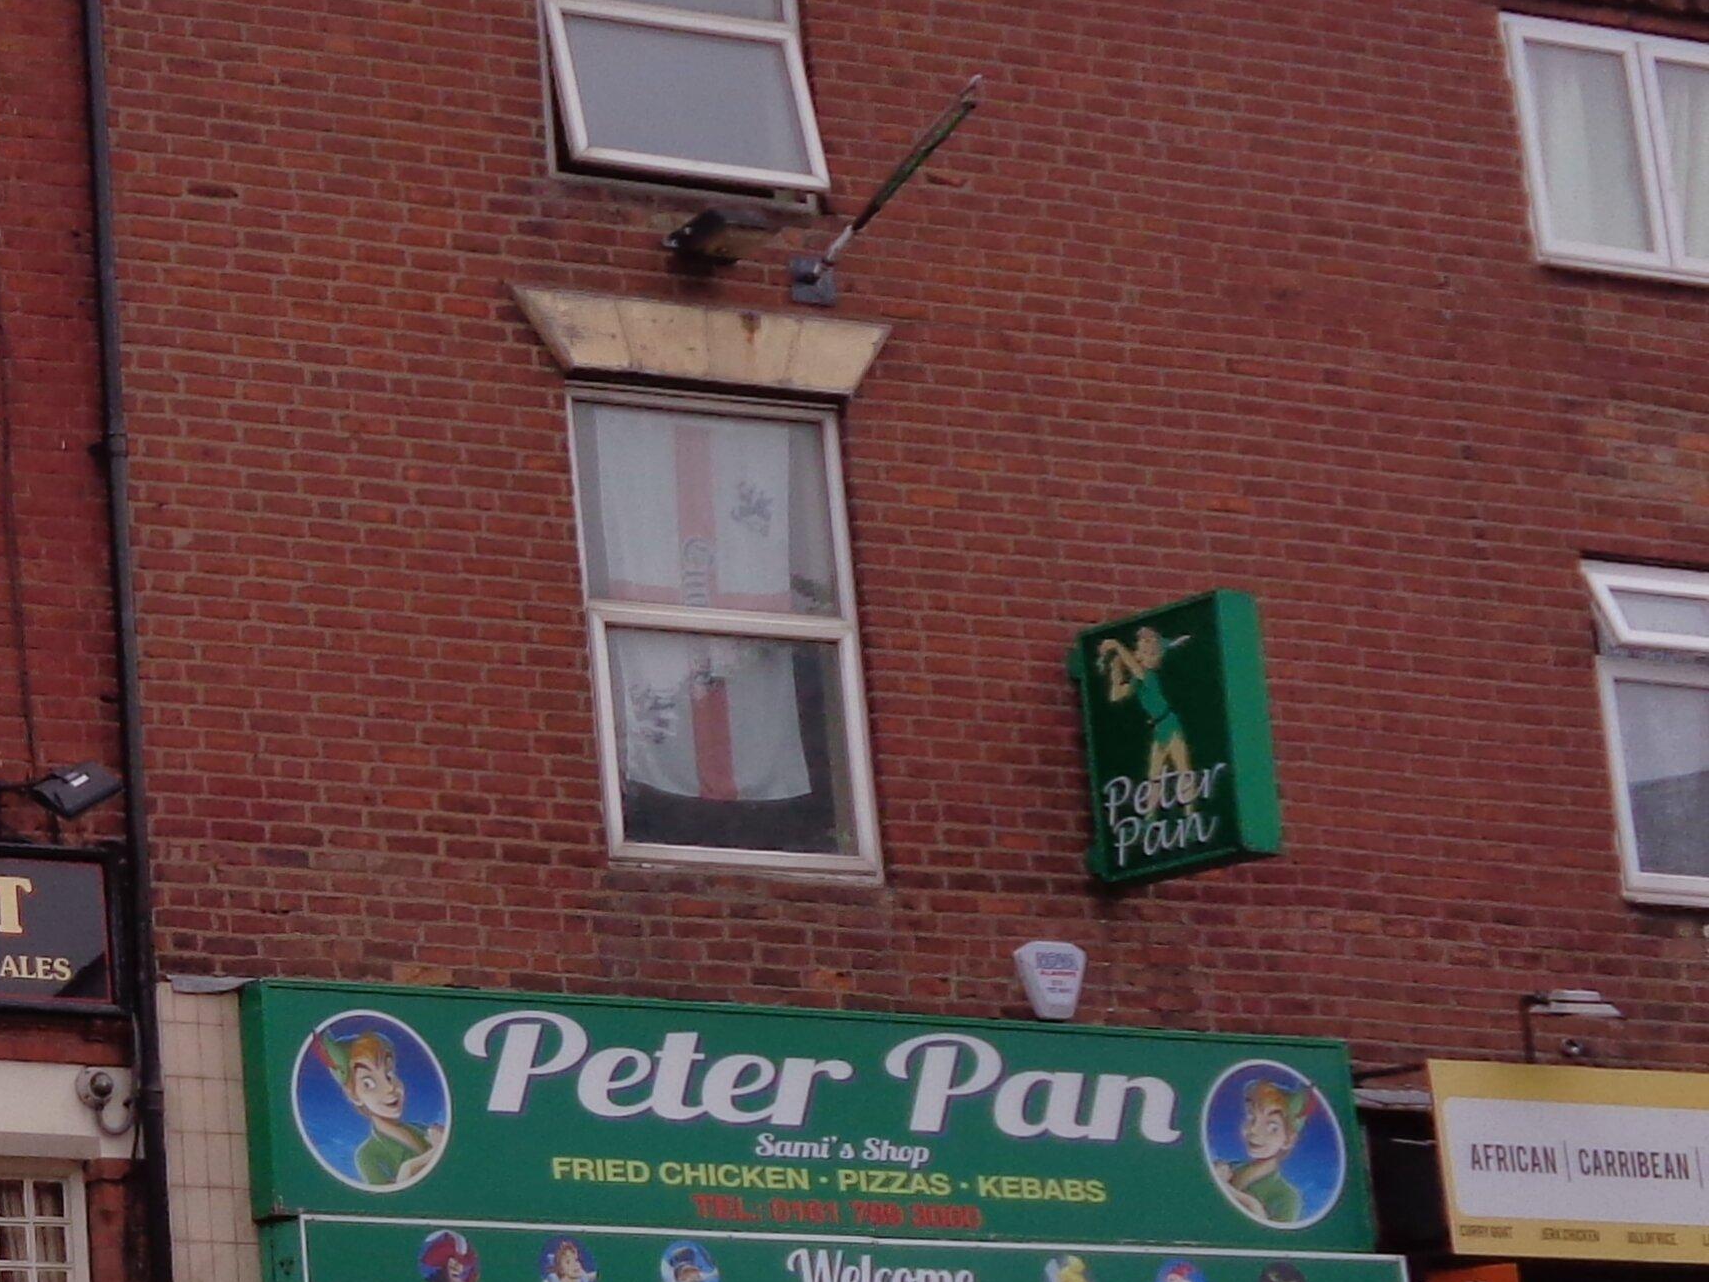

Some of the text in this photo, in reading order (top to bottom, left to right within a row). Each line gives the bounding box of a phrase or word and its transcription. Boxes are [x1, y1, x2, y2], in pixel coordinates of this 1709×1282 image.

[1103, 762, 1228, 826] Peter
[1112, 810, 1219, 867] Pan
[0, 954, 72, 982] ALES
[462, 1009, 1182, 1144] Peter Pan
[755, 1132, 930, 1169] Sami's Shop
[1470, 1142, 1690, 1181] AFRICAN CARRIBEAN
[552, 1157, 1107, 1204] FRIED CHICKEN PIZZAS KEBABS
